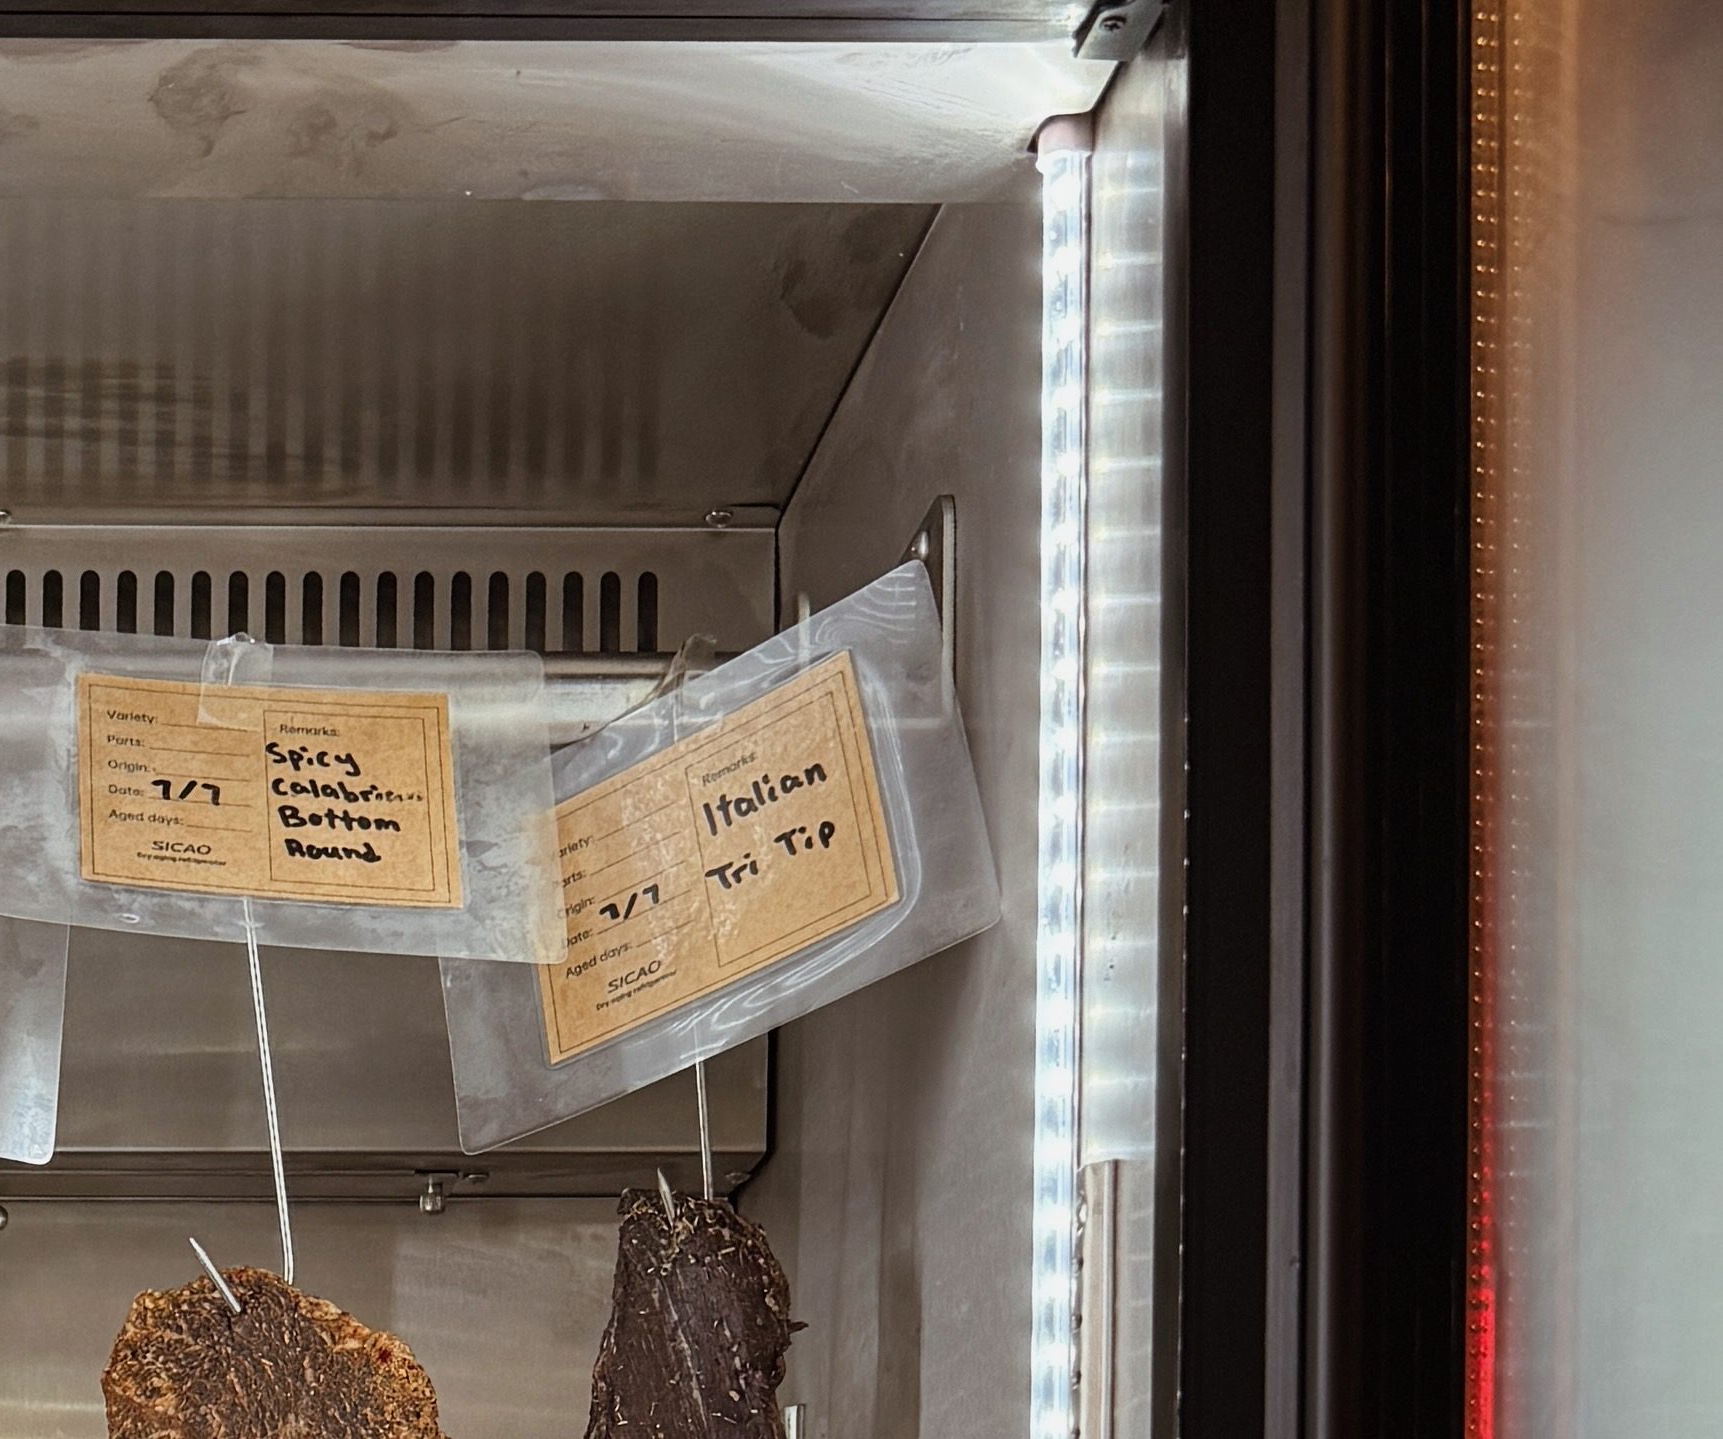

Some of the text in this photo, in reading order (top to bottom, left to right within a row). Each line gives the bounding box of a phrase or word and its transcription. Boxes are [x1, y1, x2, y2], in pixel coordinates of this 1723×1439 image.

[107, 710, 158, 725] Variety:
[280, 723, 341, 738] Remarks:
[107, 734, 145, 748] Parts:
[265, 742, 361, 777] Spicy
[108, 779, 221, 806] Date: 7/7
[702, 762, 828, 837] Italian
[109, 809, 185, 827] Aged days:
[278, 805, 401, 832] Bottom
[152, 840, 212, 856] SICAO
[284, 838, 382, 863] Round
[704, 852, 759, 890] Tri
[565, 942, 633, 979] Aged days:
[608, 960, 662, 994] SICAO
